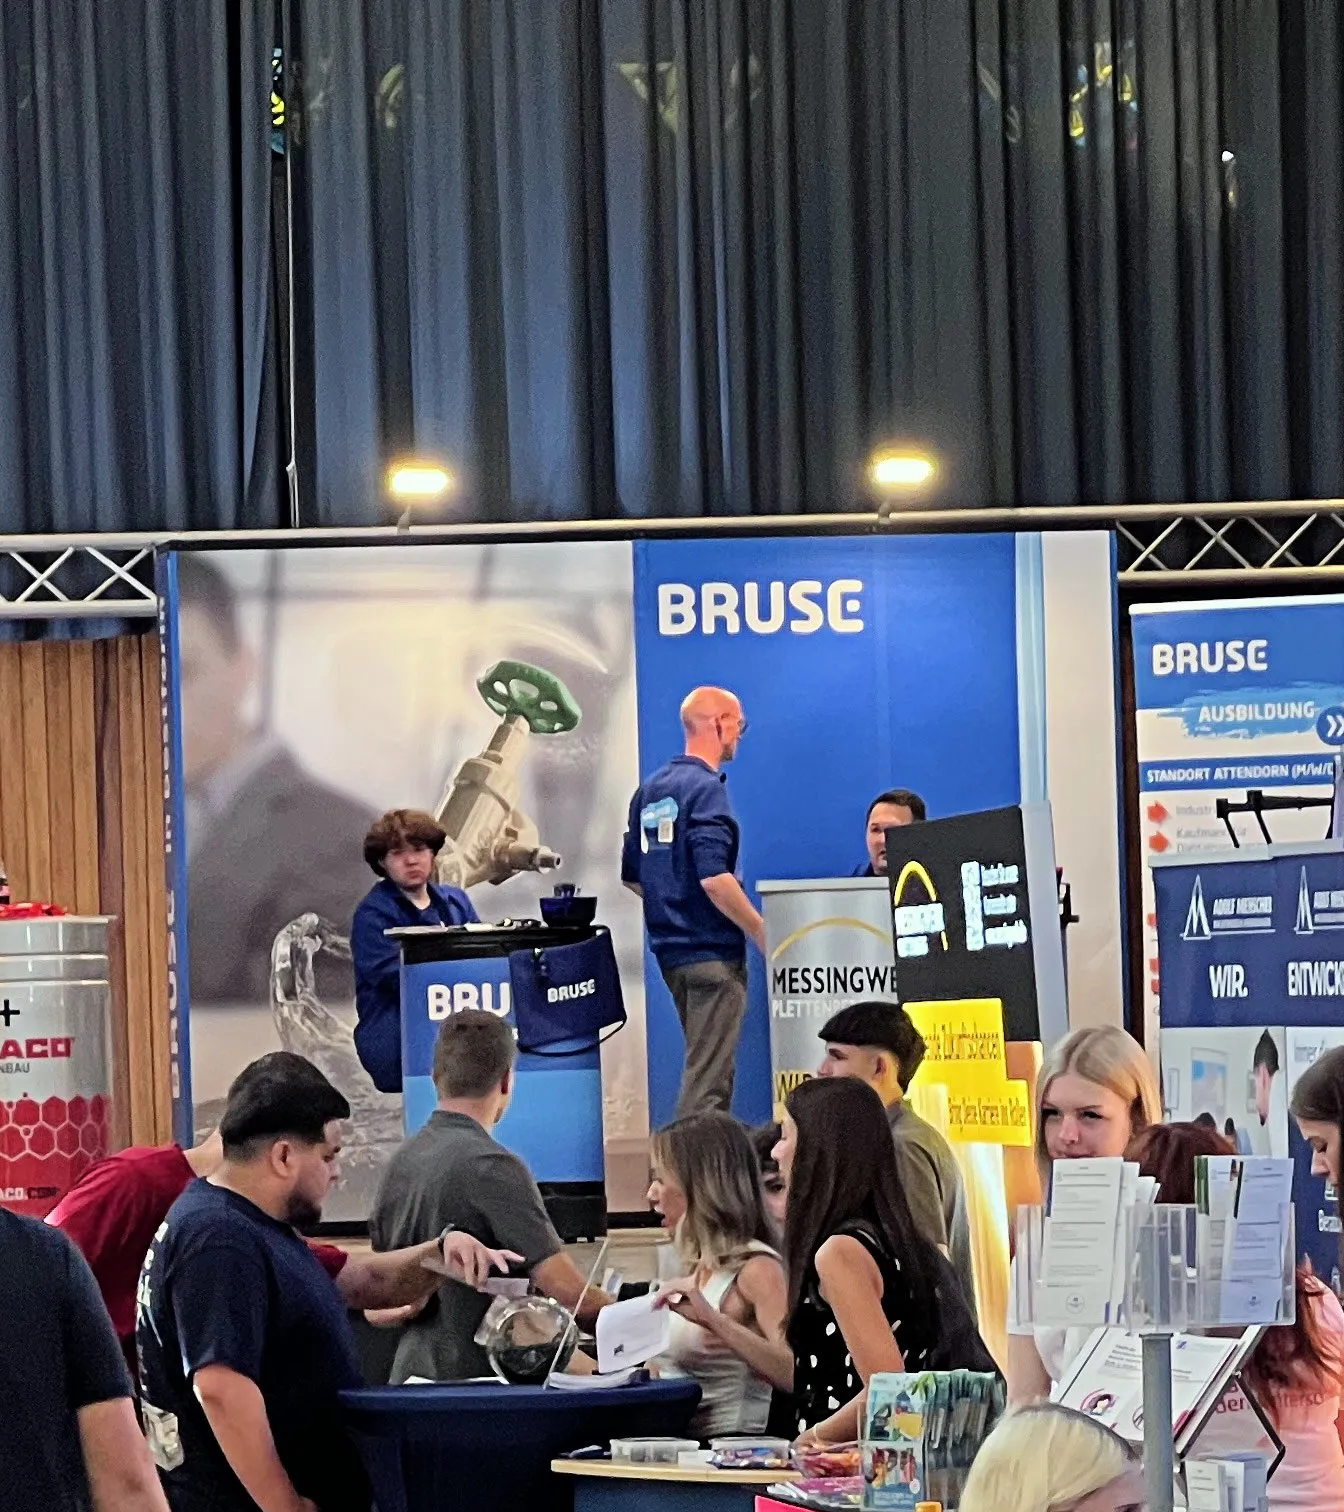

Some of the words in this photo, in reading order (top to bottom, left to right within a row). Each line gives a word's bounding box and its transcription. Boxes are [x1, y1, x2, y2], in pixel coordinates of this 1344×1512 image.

[657, 579, 864, 635] BRUSE
[1152, 639, 1268, 675] BRUSE
[1198, 701, 1315, 723] AUSBILDUNG
[1147, 767, 1211, 783] STANDORT
[1213, 765, 1289, 781] ATTENDORN
[547, 978, 596, 1003] BRUSE
